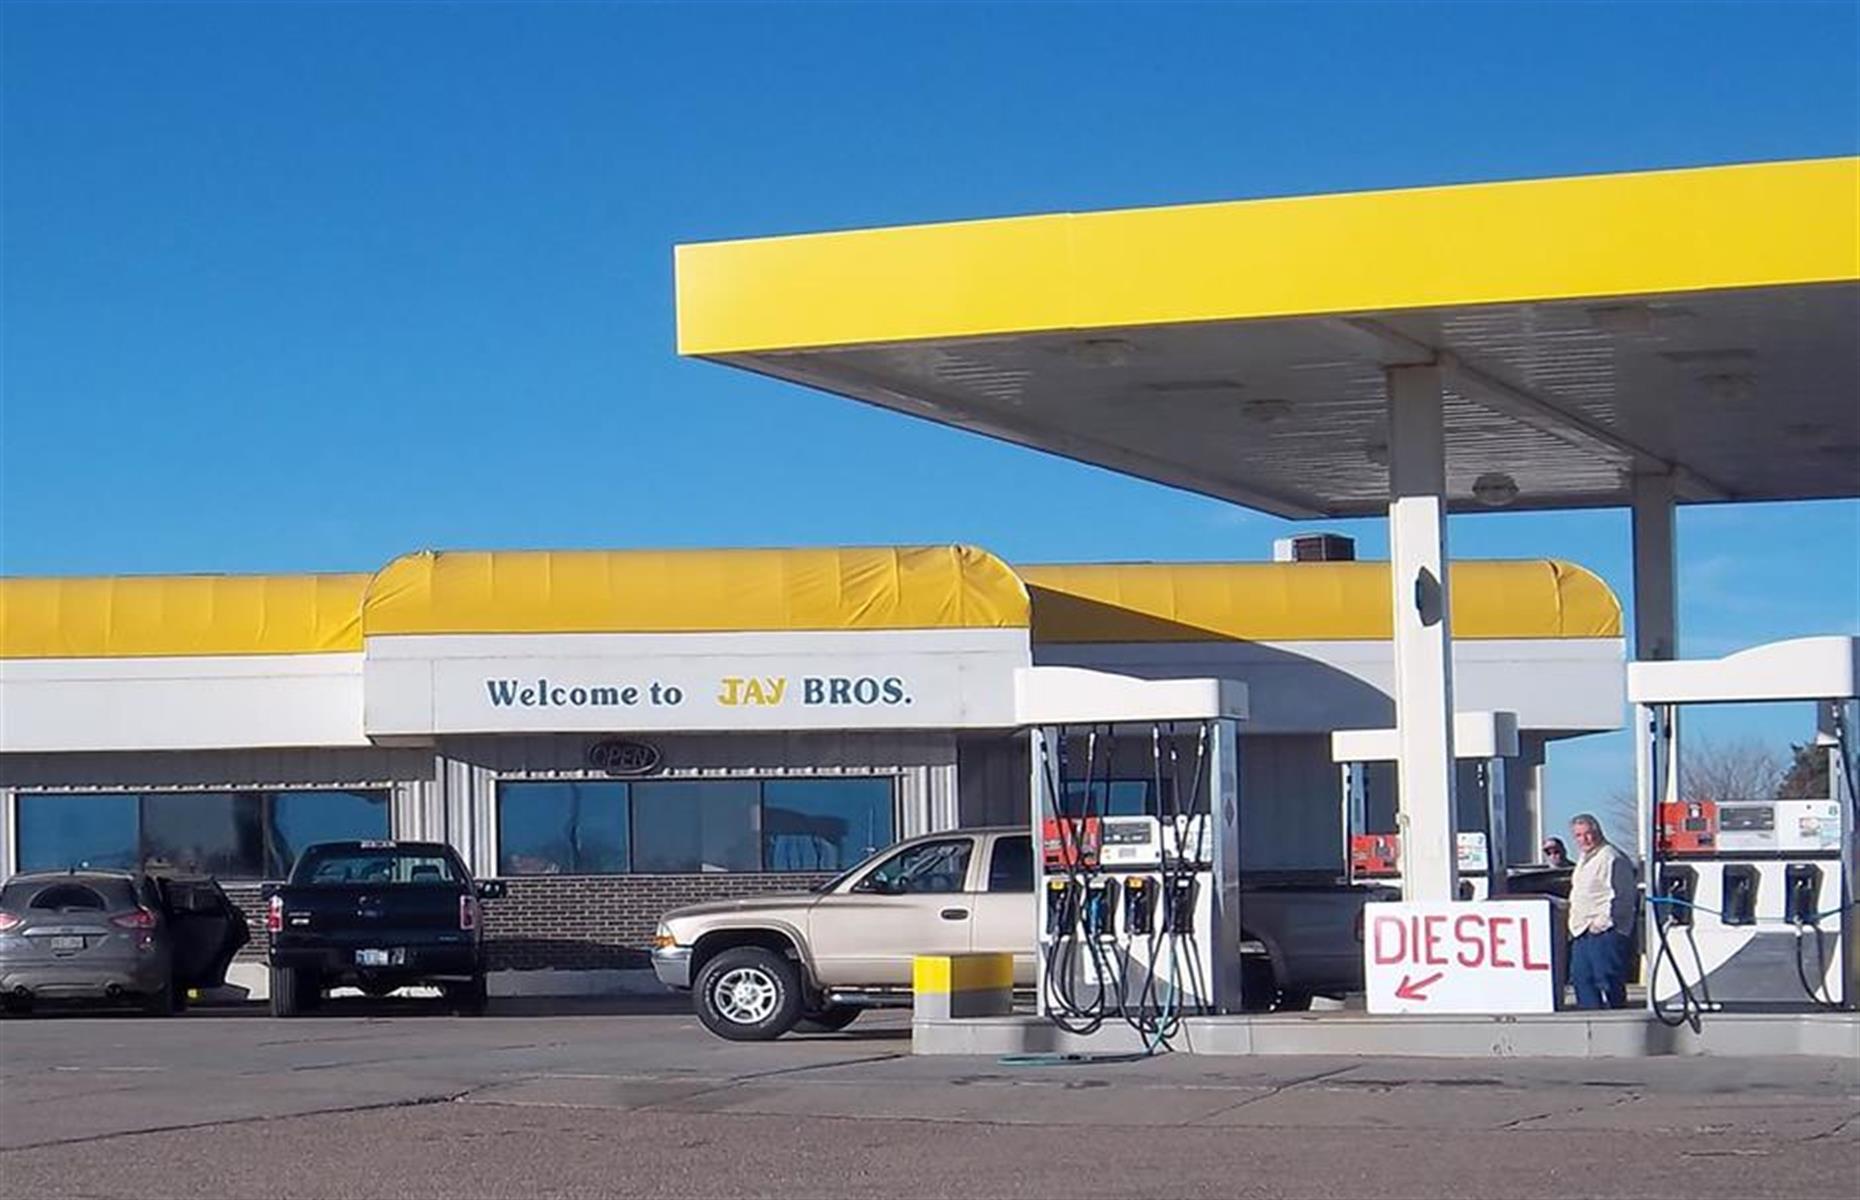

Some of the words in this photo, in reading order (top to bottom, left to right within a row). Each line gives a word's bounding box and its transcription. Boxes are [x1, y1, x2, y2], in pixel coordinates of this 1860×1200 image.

[488, 679, 639, 706] Welcome
[649, 681, 683, 706] to
[718, 677, 786, 706] JAY
[803, 677, 912, 705] BROS.
[592, 745, 649, 769] OPEN
[1374, 914, 1550, 971] DIESEL
